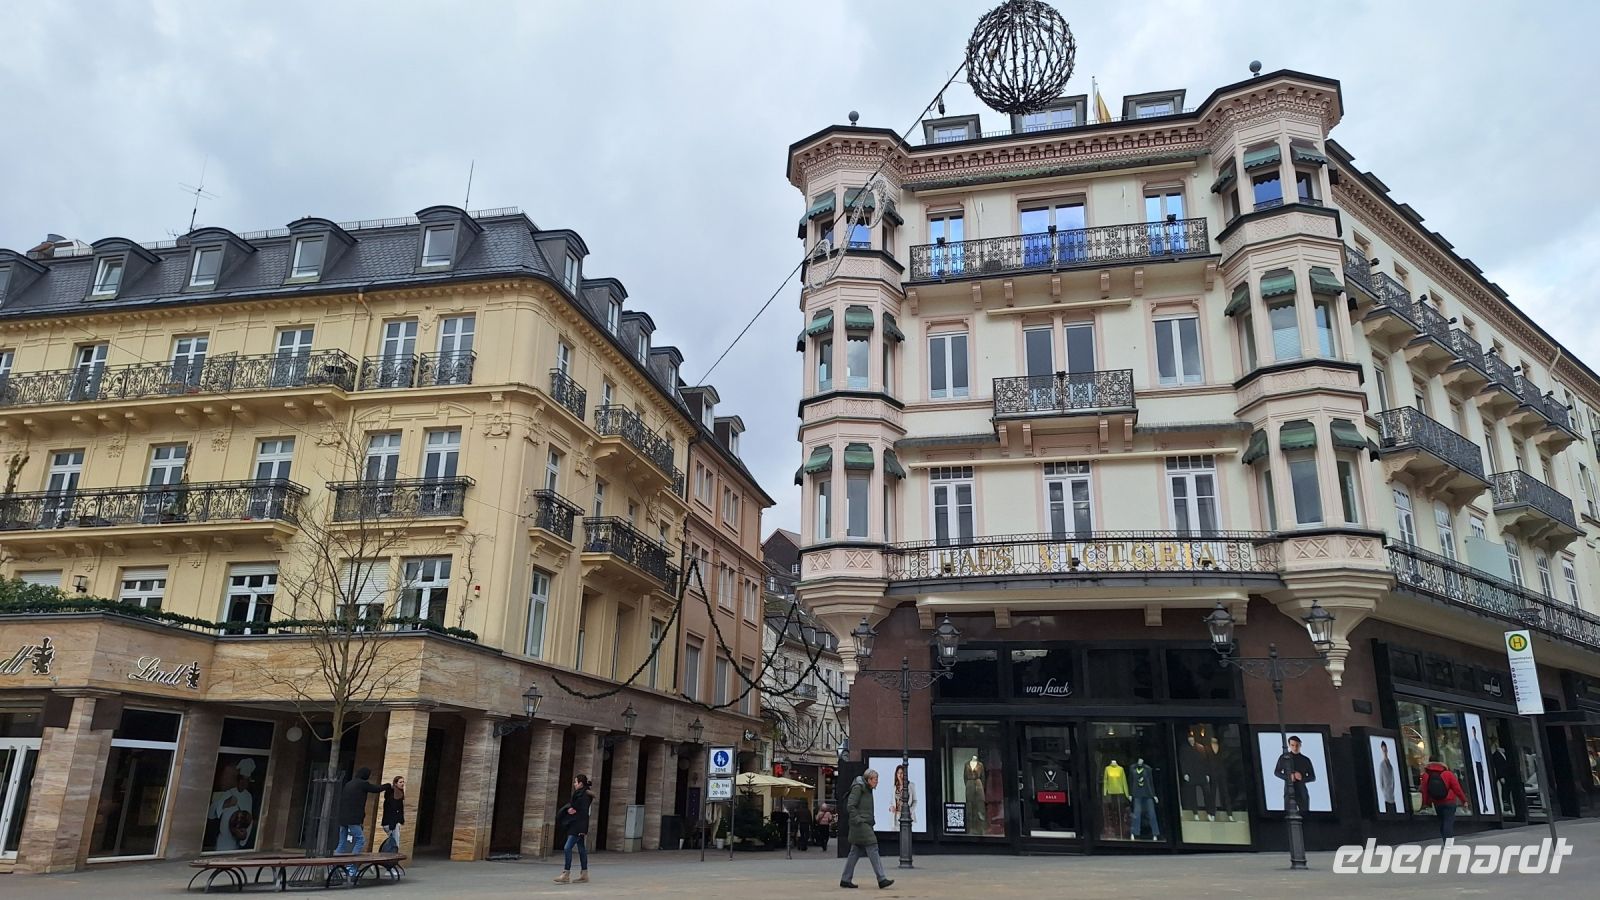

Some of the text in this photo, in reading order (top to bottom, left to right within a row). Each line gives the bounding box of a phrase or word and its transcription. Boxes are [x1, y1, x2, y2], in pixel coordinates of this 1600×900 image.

[939, 541, 1218, 575] HAUS VICTORIA
[1513, 637, 1523, 648] H
[127, 656, 190, 686] Lindt
[1026, 677, 1073, 697] van Laack
